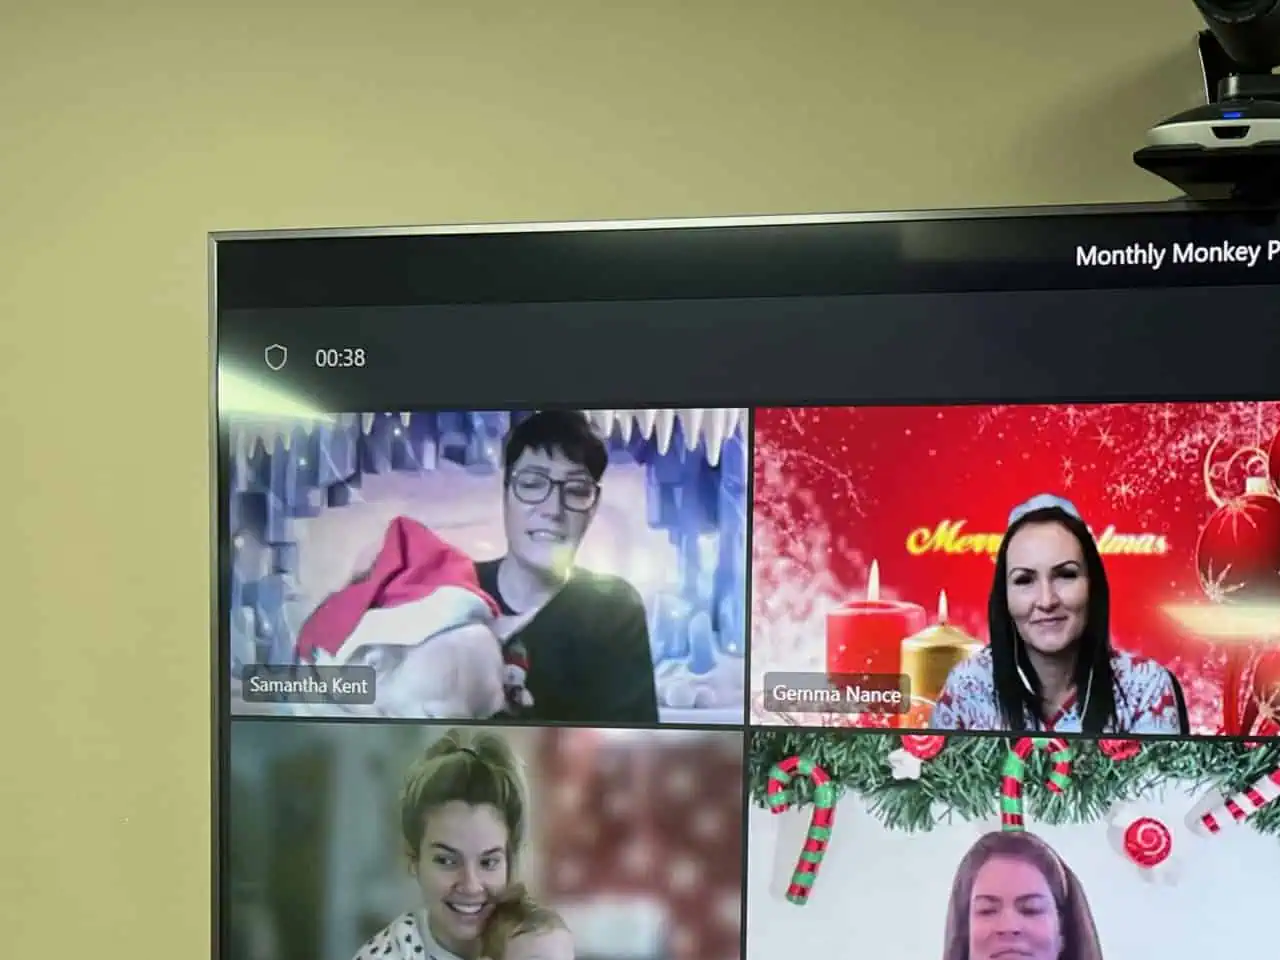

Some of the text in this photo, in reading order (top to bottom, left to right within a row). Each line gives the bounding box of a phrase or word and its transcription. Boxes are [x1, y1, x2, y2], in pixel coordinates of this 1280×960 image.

[1076, 243, 1165, 270] Monthly
[1172, 241, 1261, 267] Monkey
[315, 347, 366, 368] 00:38
[249, 675, 369, 694] Samantha Kent
[772, 684, 902, 703] Gemma Nance
